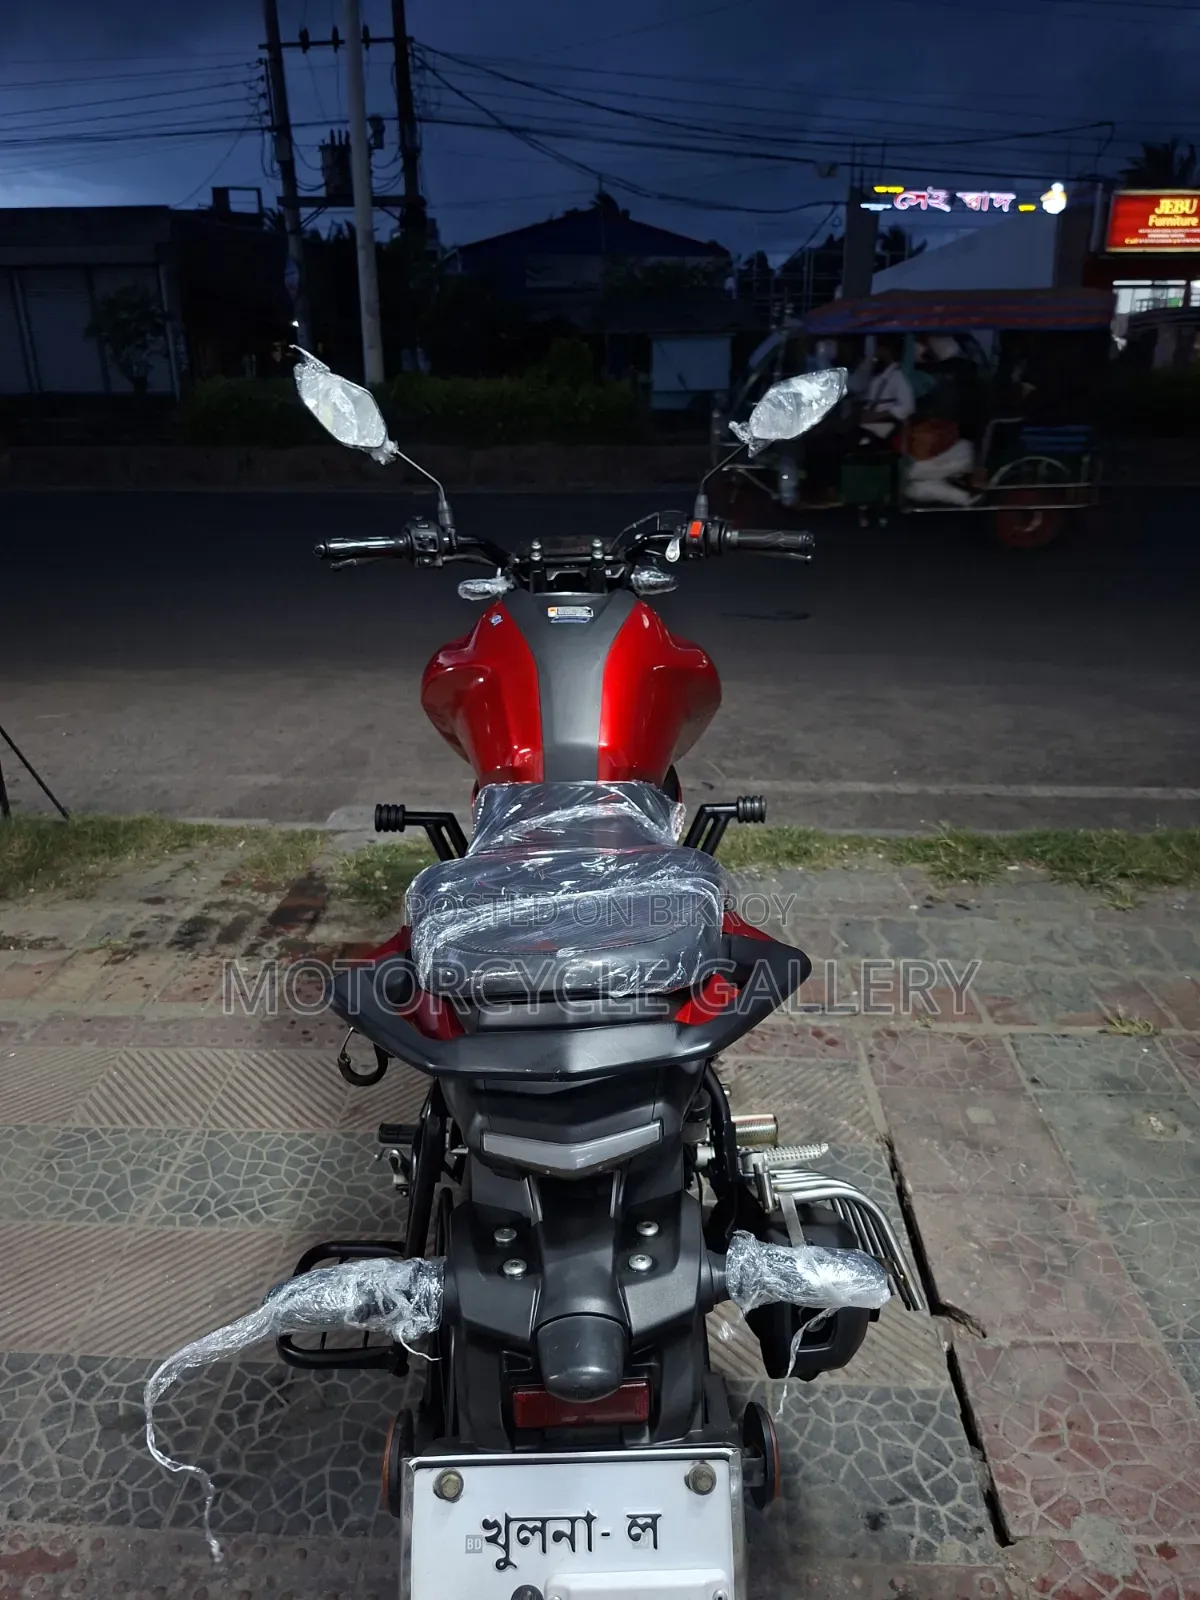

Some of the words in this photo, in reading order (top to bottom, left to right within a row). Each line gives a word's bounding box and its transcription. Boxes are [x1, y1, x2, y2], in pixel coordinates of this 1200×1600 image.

[1154, 198, 1198, 215] JEBU
[1147, 214, 1199, 227] Furniture
[626, 1513, 662, 1550] ল
[466, 1537, 482, 1551] BD
